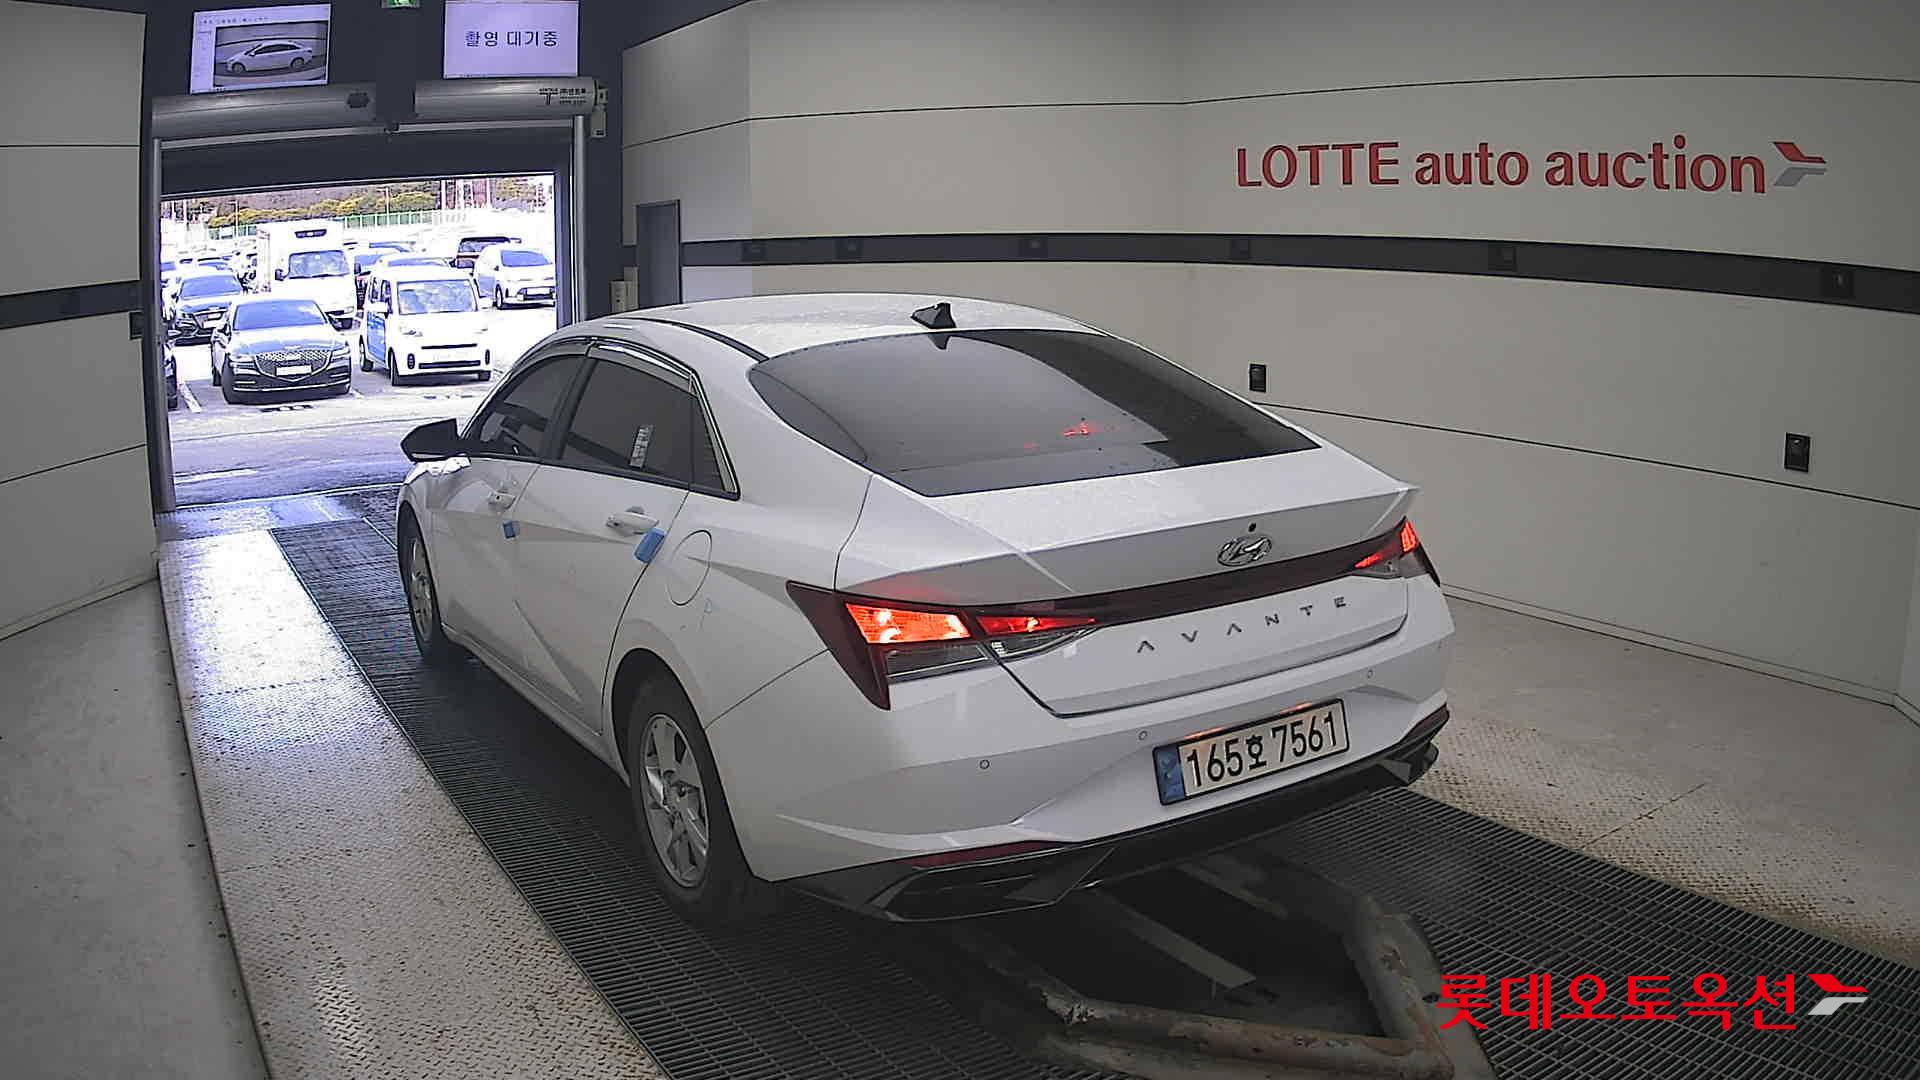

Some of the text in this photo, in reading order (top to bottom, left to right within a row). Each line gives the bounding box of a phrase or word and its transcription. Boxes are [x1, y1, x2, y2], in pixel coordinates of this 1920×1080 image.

[507, 31, 557, 47] 대기중
[1236, 135, 1766, 194] LOTTE auto auction
[1137, 596, 1348, 653] AVANTE
